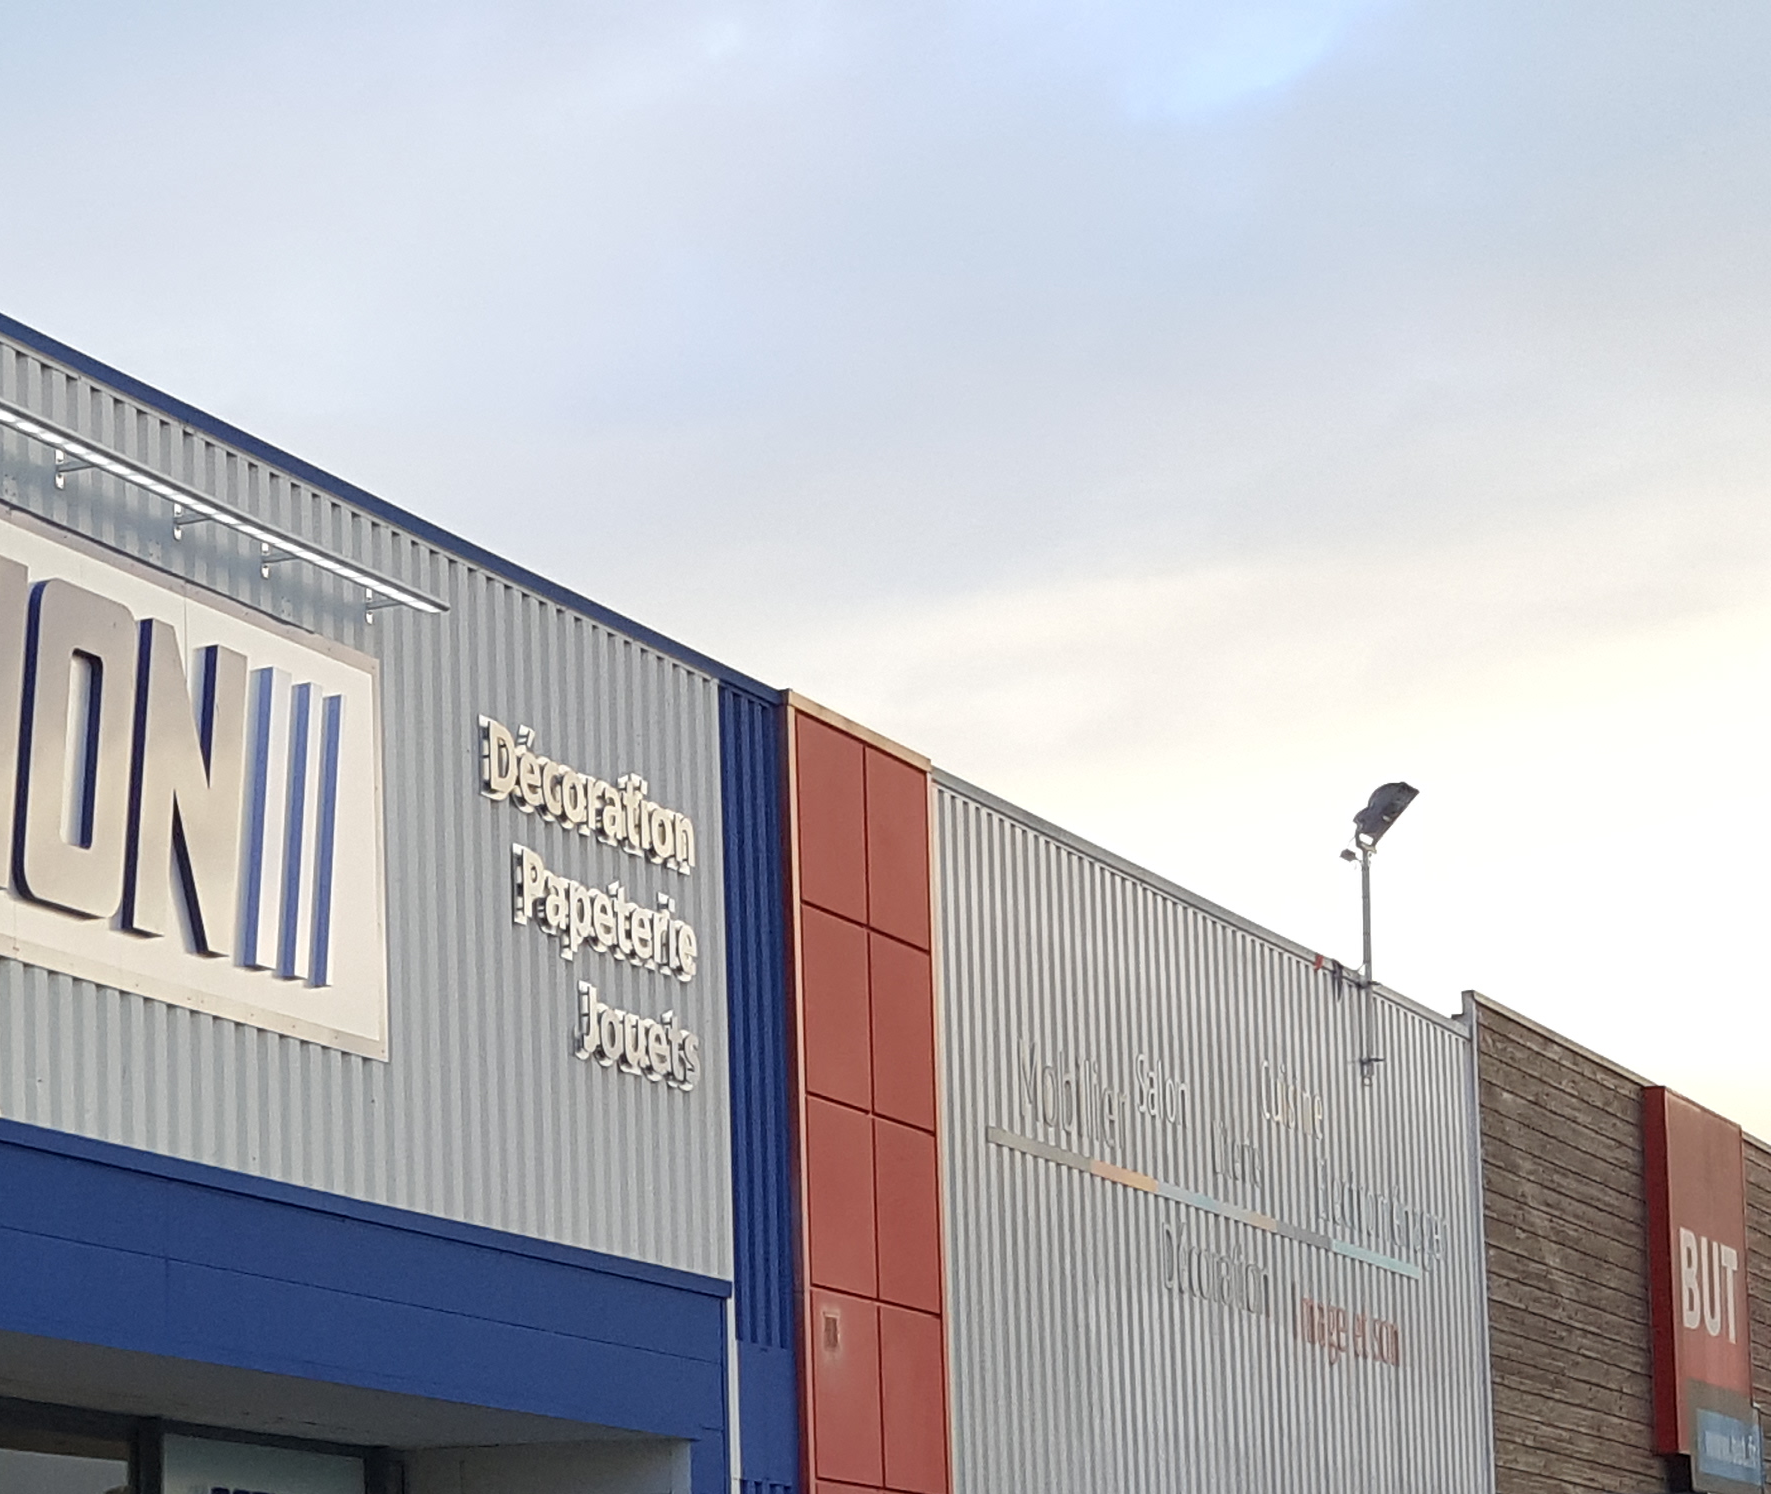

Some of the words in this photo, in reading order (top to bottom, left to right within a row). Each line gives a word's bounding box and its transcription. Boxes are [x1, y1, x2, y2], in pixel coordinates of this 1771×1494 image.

[479, 714, 696, 876] Décoration
[512, 842, 698, 982] Papeterie
[574, 980, 701, 1092] Jouets
[1016, 1036, 1129, 1150] Mobilier
[1135, 1052, 1189, 1130] Salon
[1260, 1058, 1324, 1141] Cuisine
[1678, 1226, 1739, 1346] BUT
